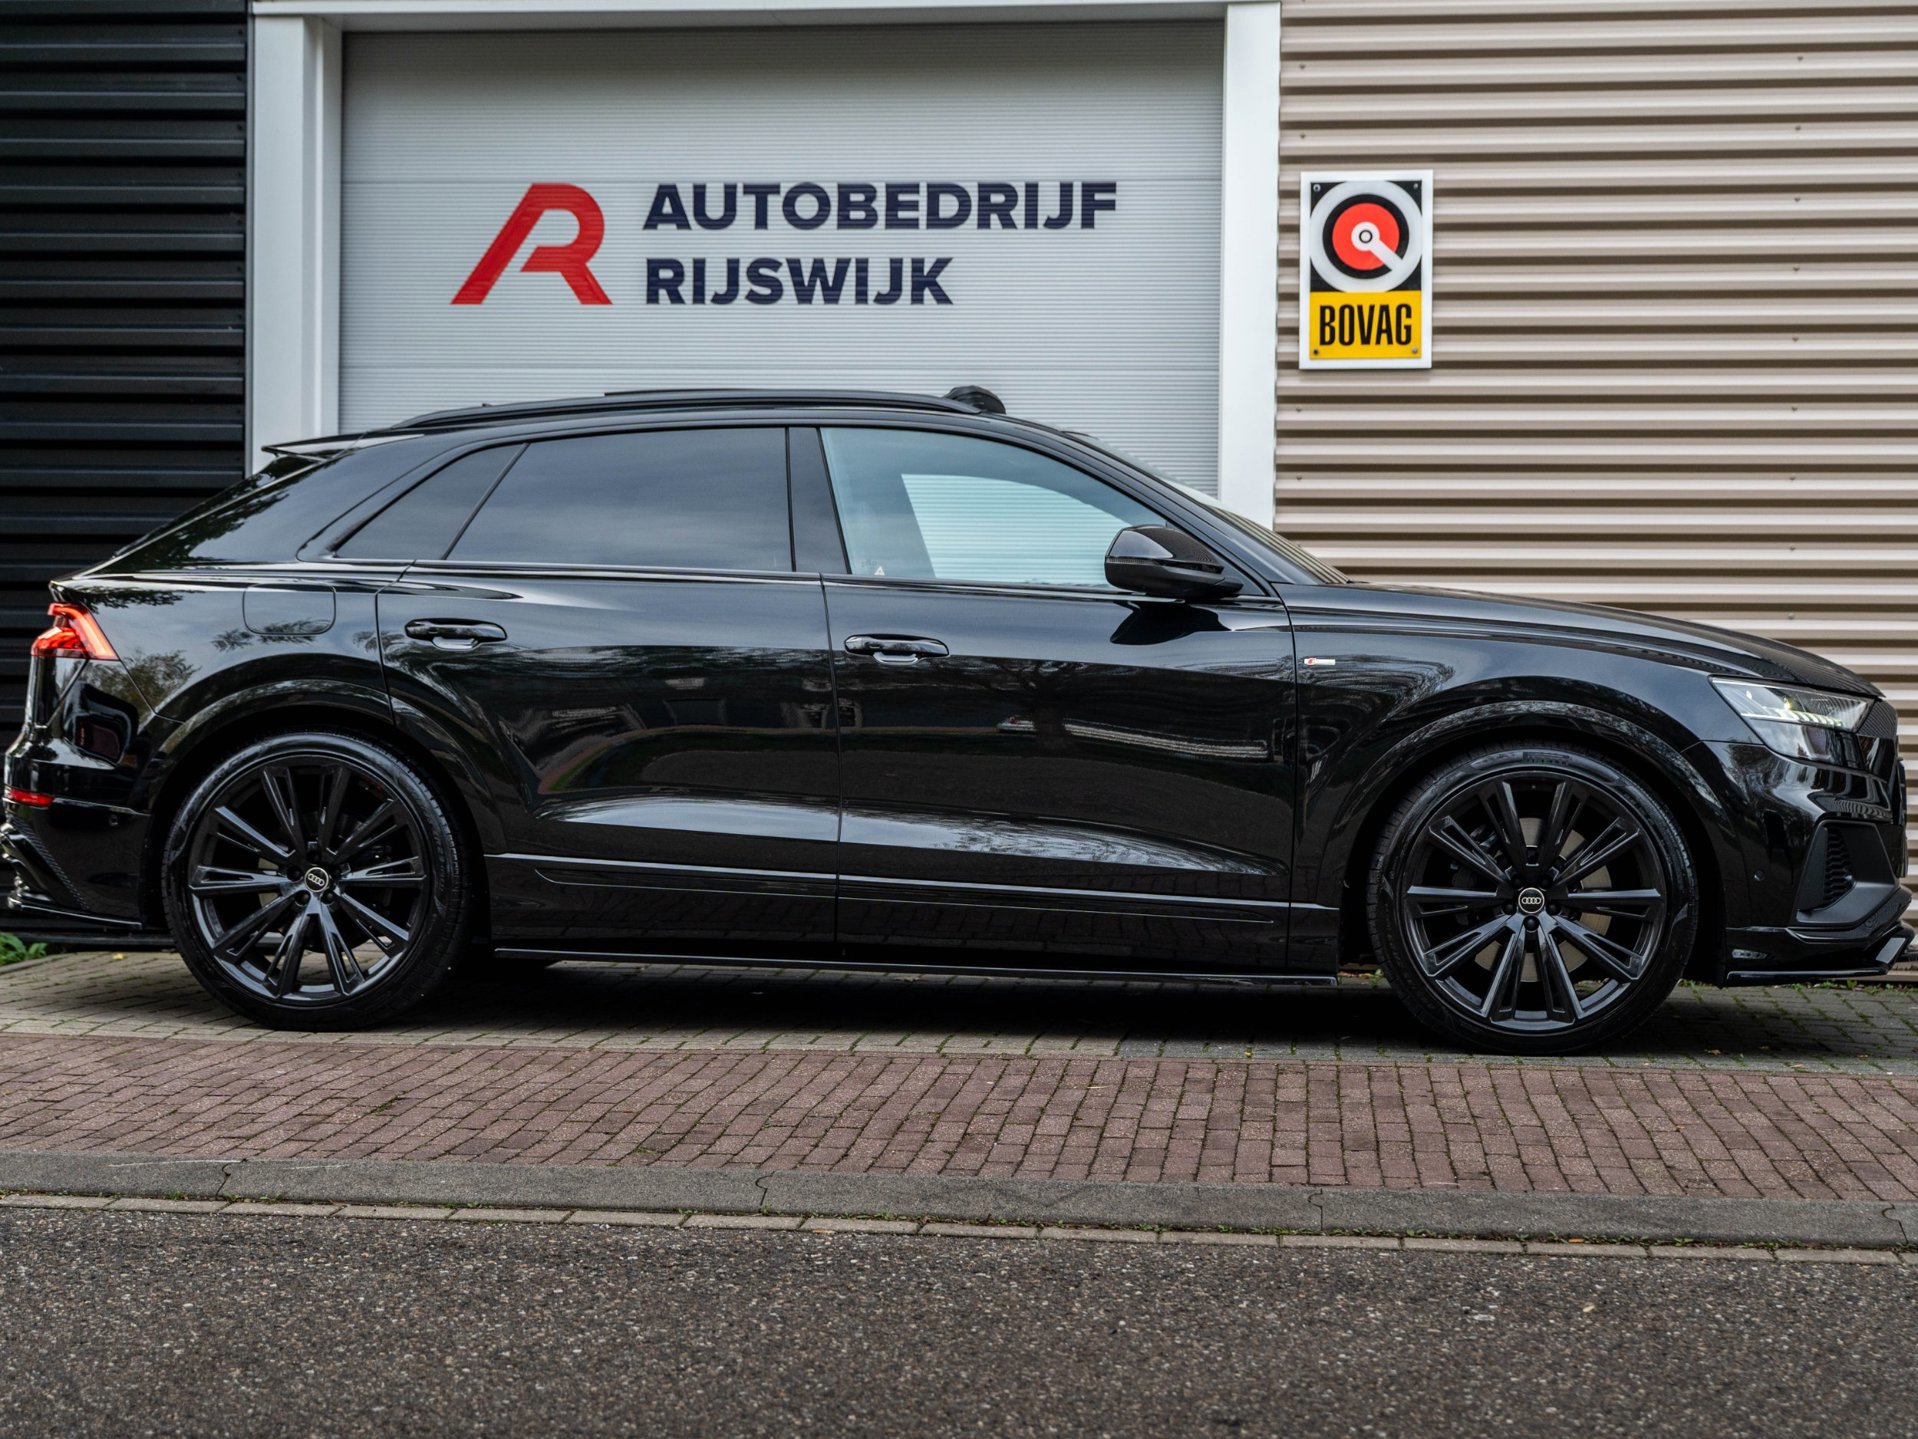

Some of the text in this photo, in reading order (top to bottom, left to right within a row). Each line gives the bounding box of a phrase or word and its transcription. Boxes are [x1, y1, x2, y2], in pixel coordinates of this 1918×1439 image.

[642, 181, 1117, 230] AUTOBEDRIJF
[645, 257, 954, 305] RIJSWIJK
[1320, 303, 1412, 346] BOVAG
